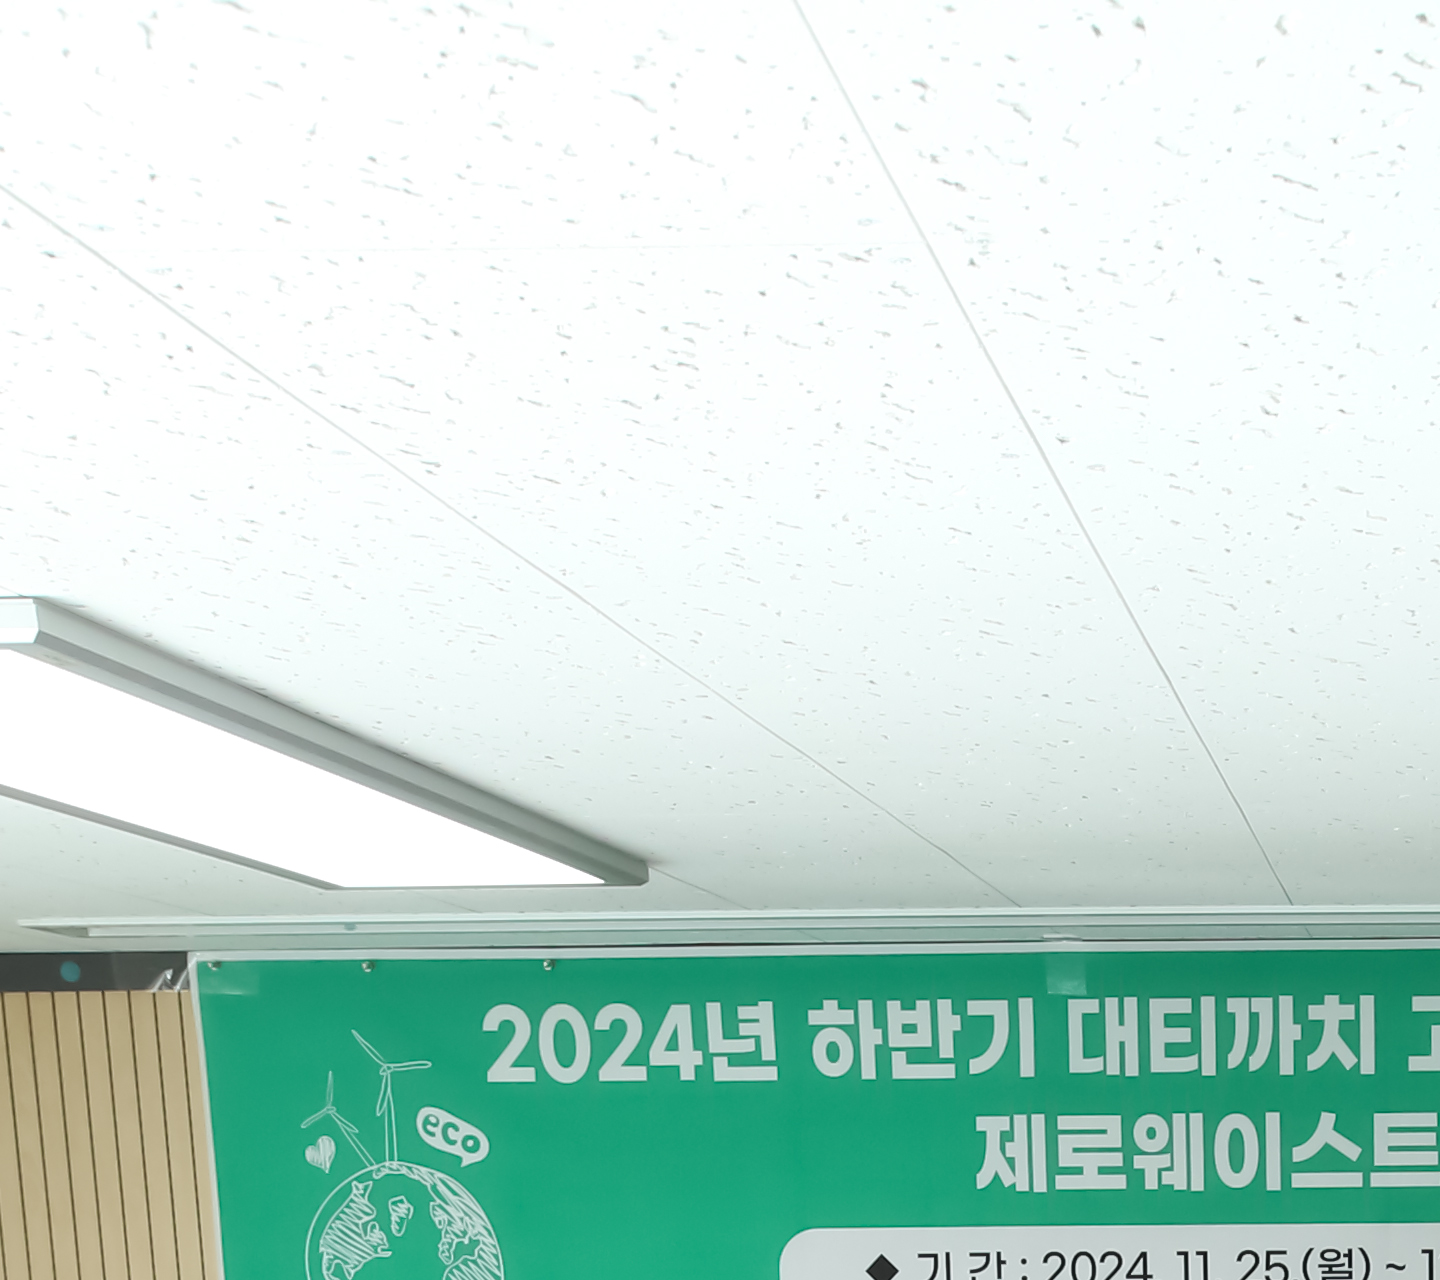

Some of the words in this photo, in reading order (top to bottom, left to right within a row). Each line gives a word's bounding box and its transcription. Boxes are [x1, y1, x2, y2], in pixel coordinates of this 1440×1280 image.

[483, 1001, 778, 1083] 2024년
[808, 998, 1035, 1079] 하반기
[1068, 995, 1375, 1076] 대티까치
[421, 1113, 481, 1154] eco
[976, 1112, 1440, 1192] 제로웨이스트
